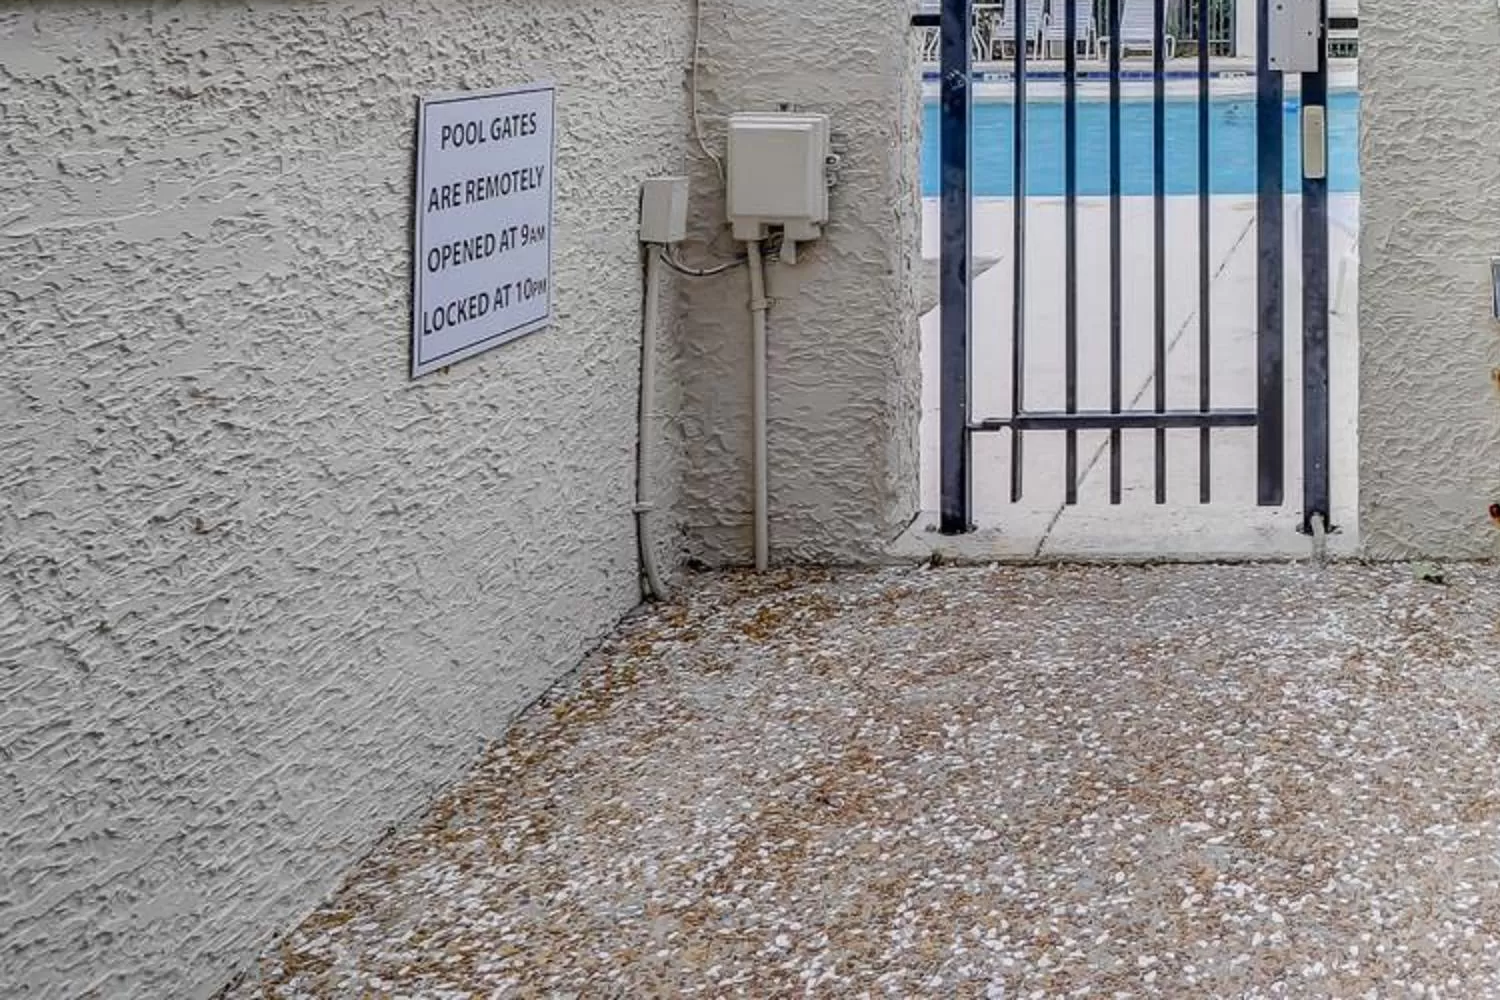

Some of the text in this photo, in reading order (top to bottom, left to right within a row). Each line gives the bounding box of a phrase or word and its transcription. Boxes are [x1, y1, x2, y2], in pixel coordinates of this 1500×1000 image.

[441, 112, 537, 150] POOL GATES
[428, 165, 545, 213] ARE REMOTELY
[427, 233, 496, 273] OPENED
[499, 227, 518, 254] AT
[423, 292, 489, 335] LOCKED
[493, 283, 512, 308] AT
